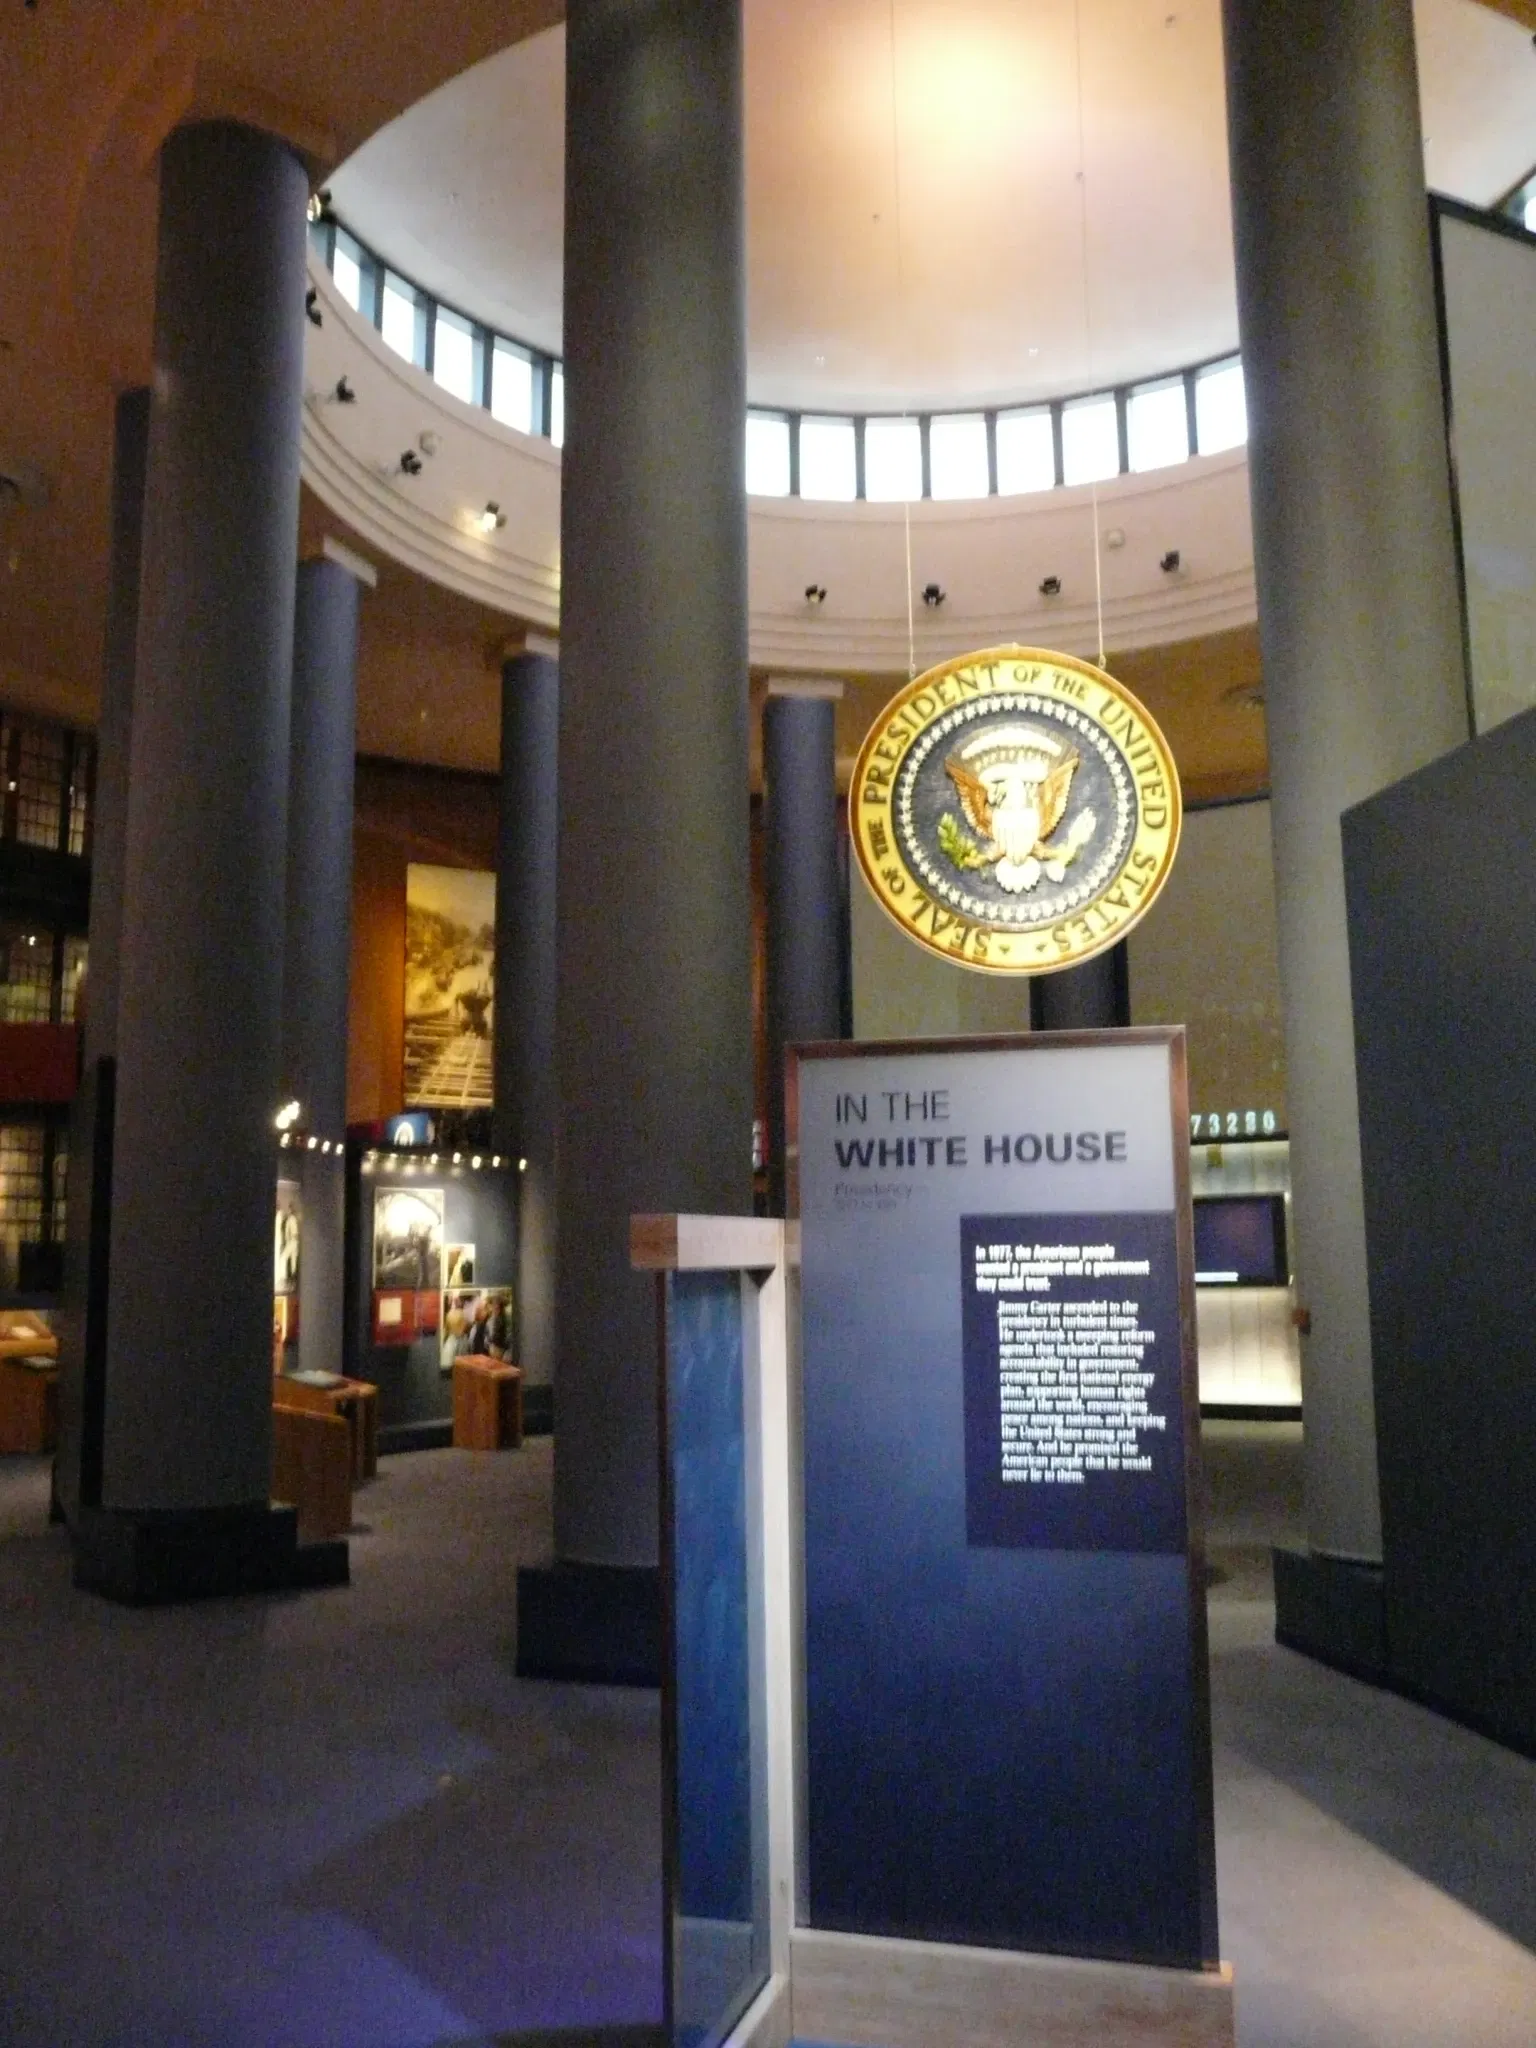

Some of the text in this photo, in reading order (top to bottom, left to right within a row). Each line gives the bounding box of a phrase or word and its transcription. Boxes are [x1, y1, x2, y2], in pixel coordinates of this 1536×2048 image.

[863, 663, 1168, 958] SEAL OF THE PRESIDENT OF THE UNITED STATES
[835, 1089, 950, 1123] IN THE
[834, 1130, 1128, 1168] WHITE HOUSE
